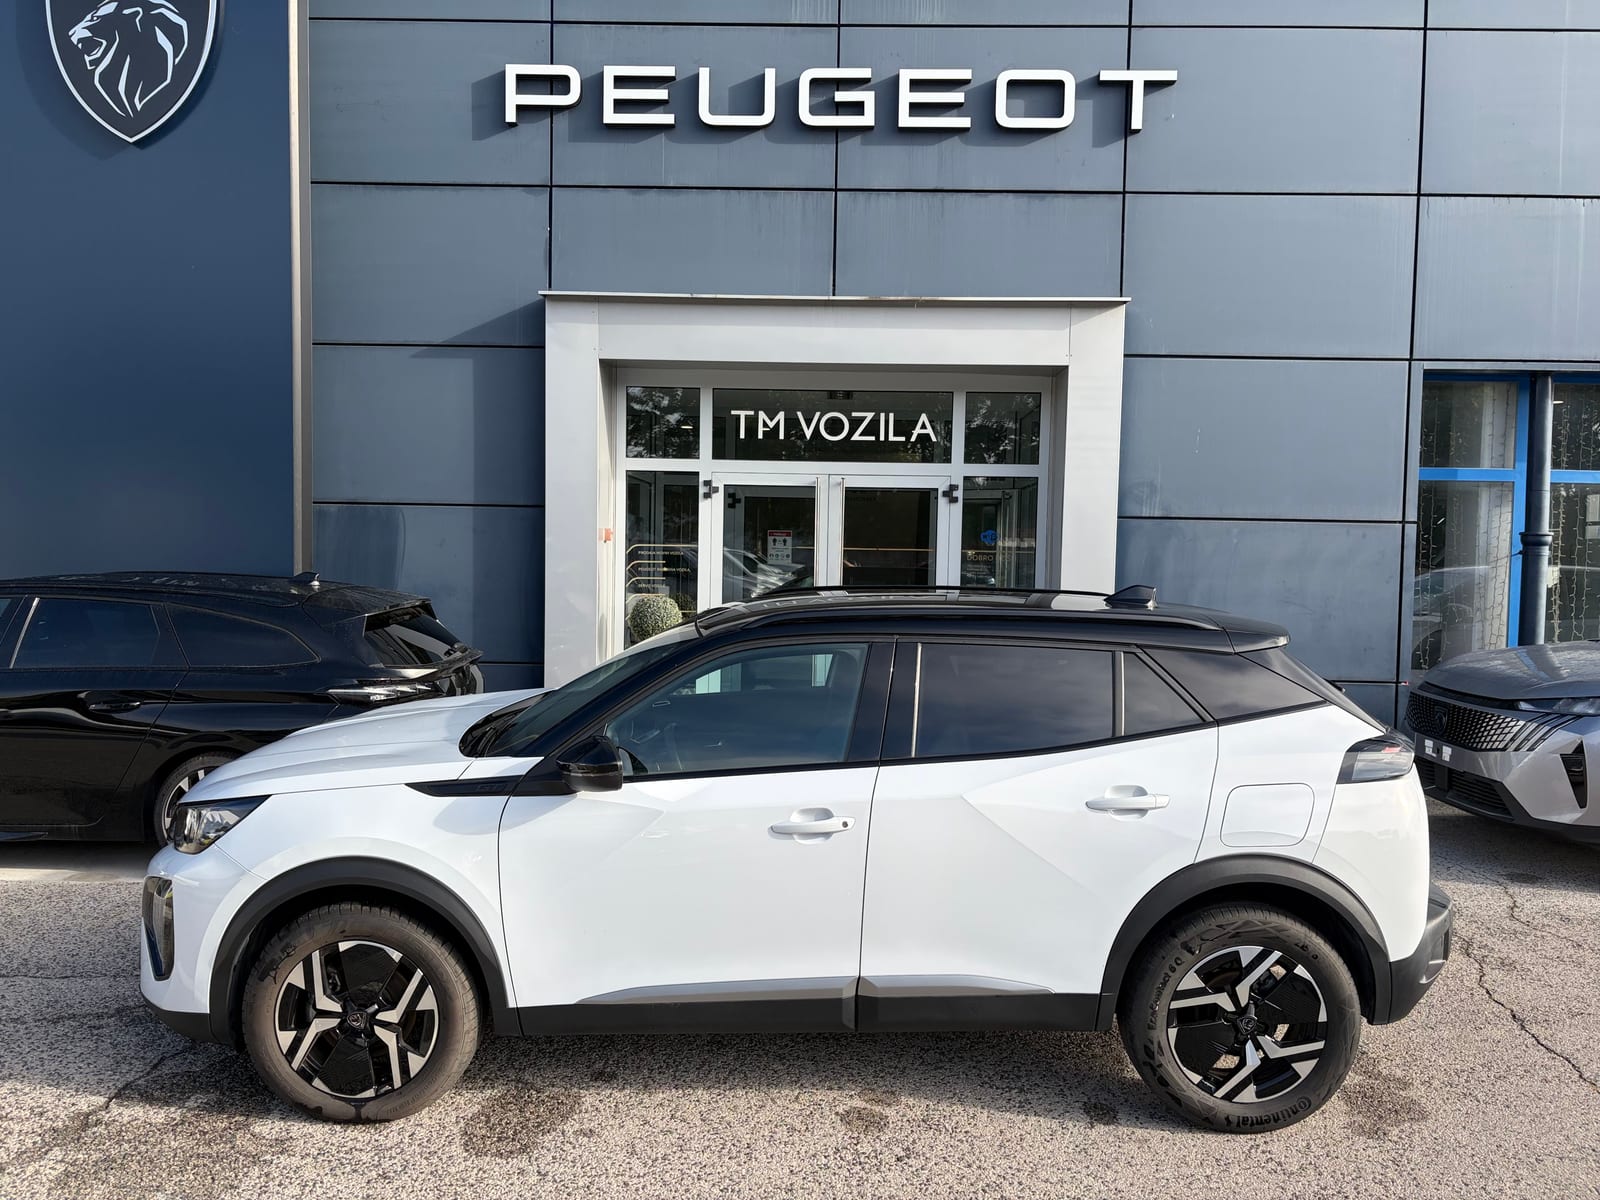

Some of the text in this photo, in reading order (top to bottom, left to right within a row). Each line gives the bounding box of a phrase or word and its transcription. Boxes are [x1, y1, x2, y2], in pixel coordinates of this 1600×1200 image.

[504, 63, 1178, 131] PEUGEOT
[731, 409, 938, 442] TM VOZILA
[1235, 1096, 1312, 1128] Continental
